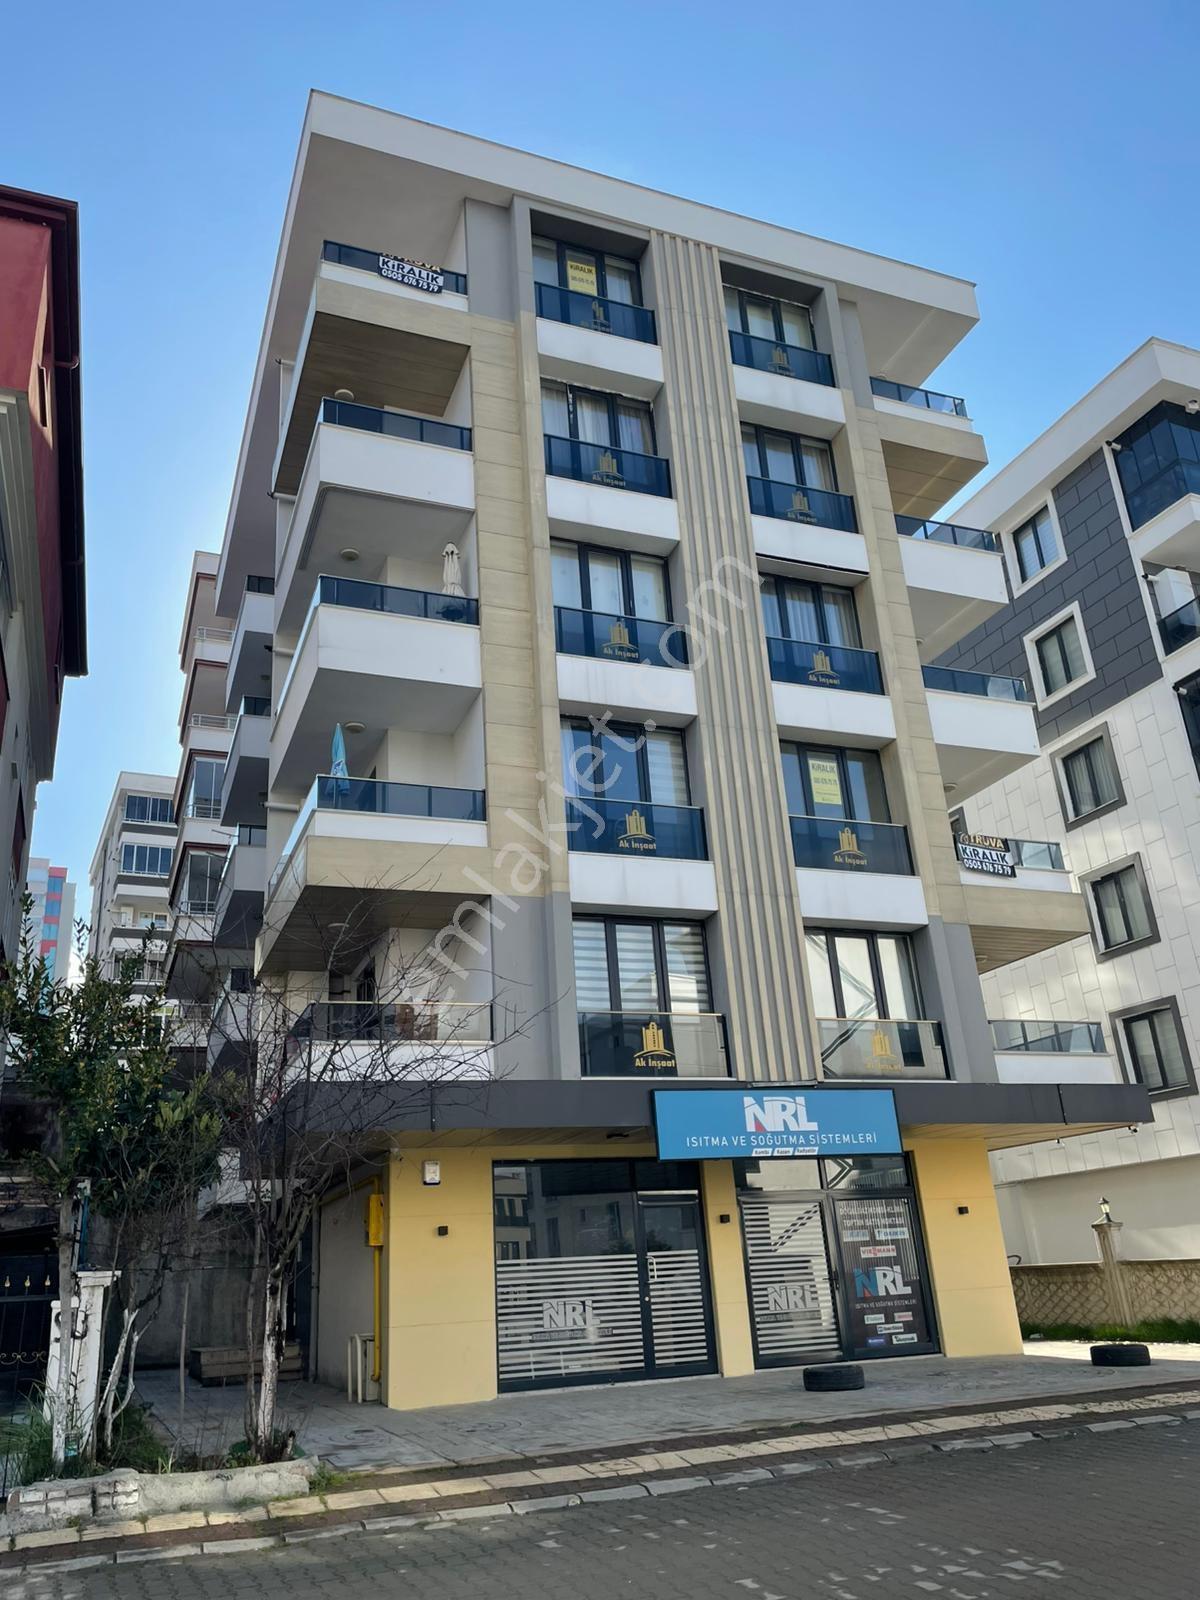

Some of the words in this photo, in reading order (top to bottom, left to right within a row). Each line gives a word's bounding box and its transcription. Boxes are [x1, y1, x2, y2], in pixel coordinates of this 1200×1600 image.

[381, 268, 402, 281] 0505
[403, 275, 417, 286] 676
[619, 839, 629, 848] Ak
[970, 834, 1005, 849] TRUVA
[635, 1057, 646, 1067] Ak
[744, 1096, 818, 1132] NRL
[686, 1136, 728, 1147] ISITMA
[731, 1135, 747, 1146] VE
[750, 1132, 806, 1146] SOĞUTMA
[809, 1130, 877, 1145] SİSTEMLERİ
[853, 1265, 912, 1297] NRL
[542, 1299, 600, 1329] NRL
